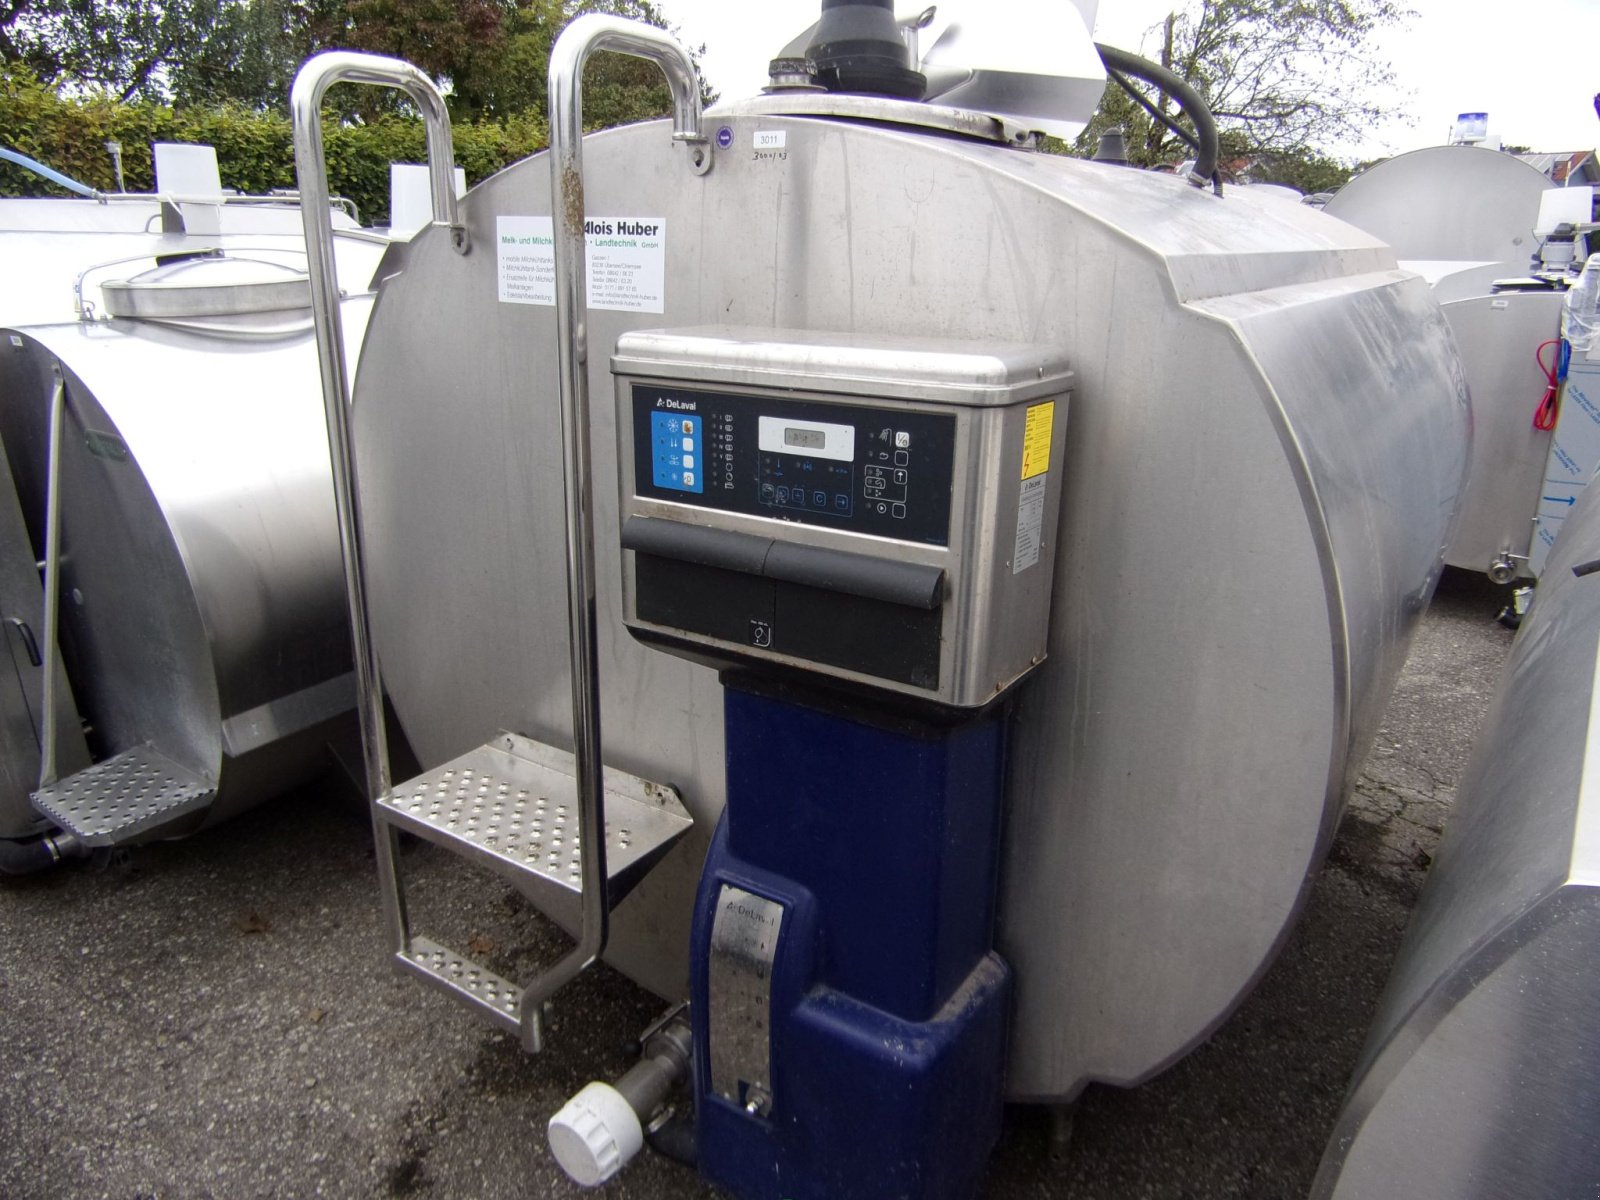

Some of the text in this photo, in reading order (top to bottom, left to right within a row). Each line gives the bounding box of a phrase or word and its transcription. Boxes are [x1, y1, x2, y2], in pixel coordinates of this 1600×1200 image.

[760, 135, 777, 145] 3011
[584, 221, 659, 236] Alois Huber
[502, 235, 553, 245] Melk- und Milchk
[595, 238, 637, 248] Landtechnik
[666, 398, 697, 411] DeLaval
[738, 905, 775, 927] DeLavl
